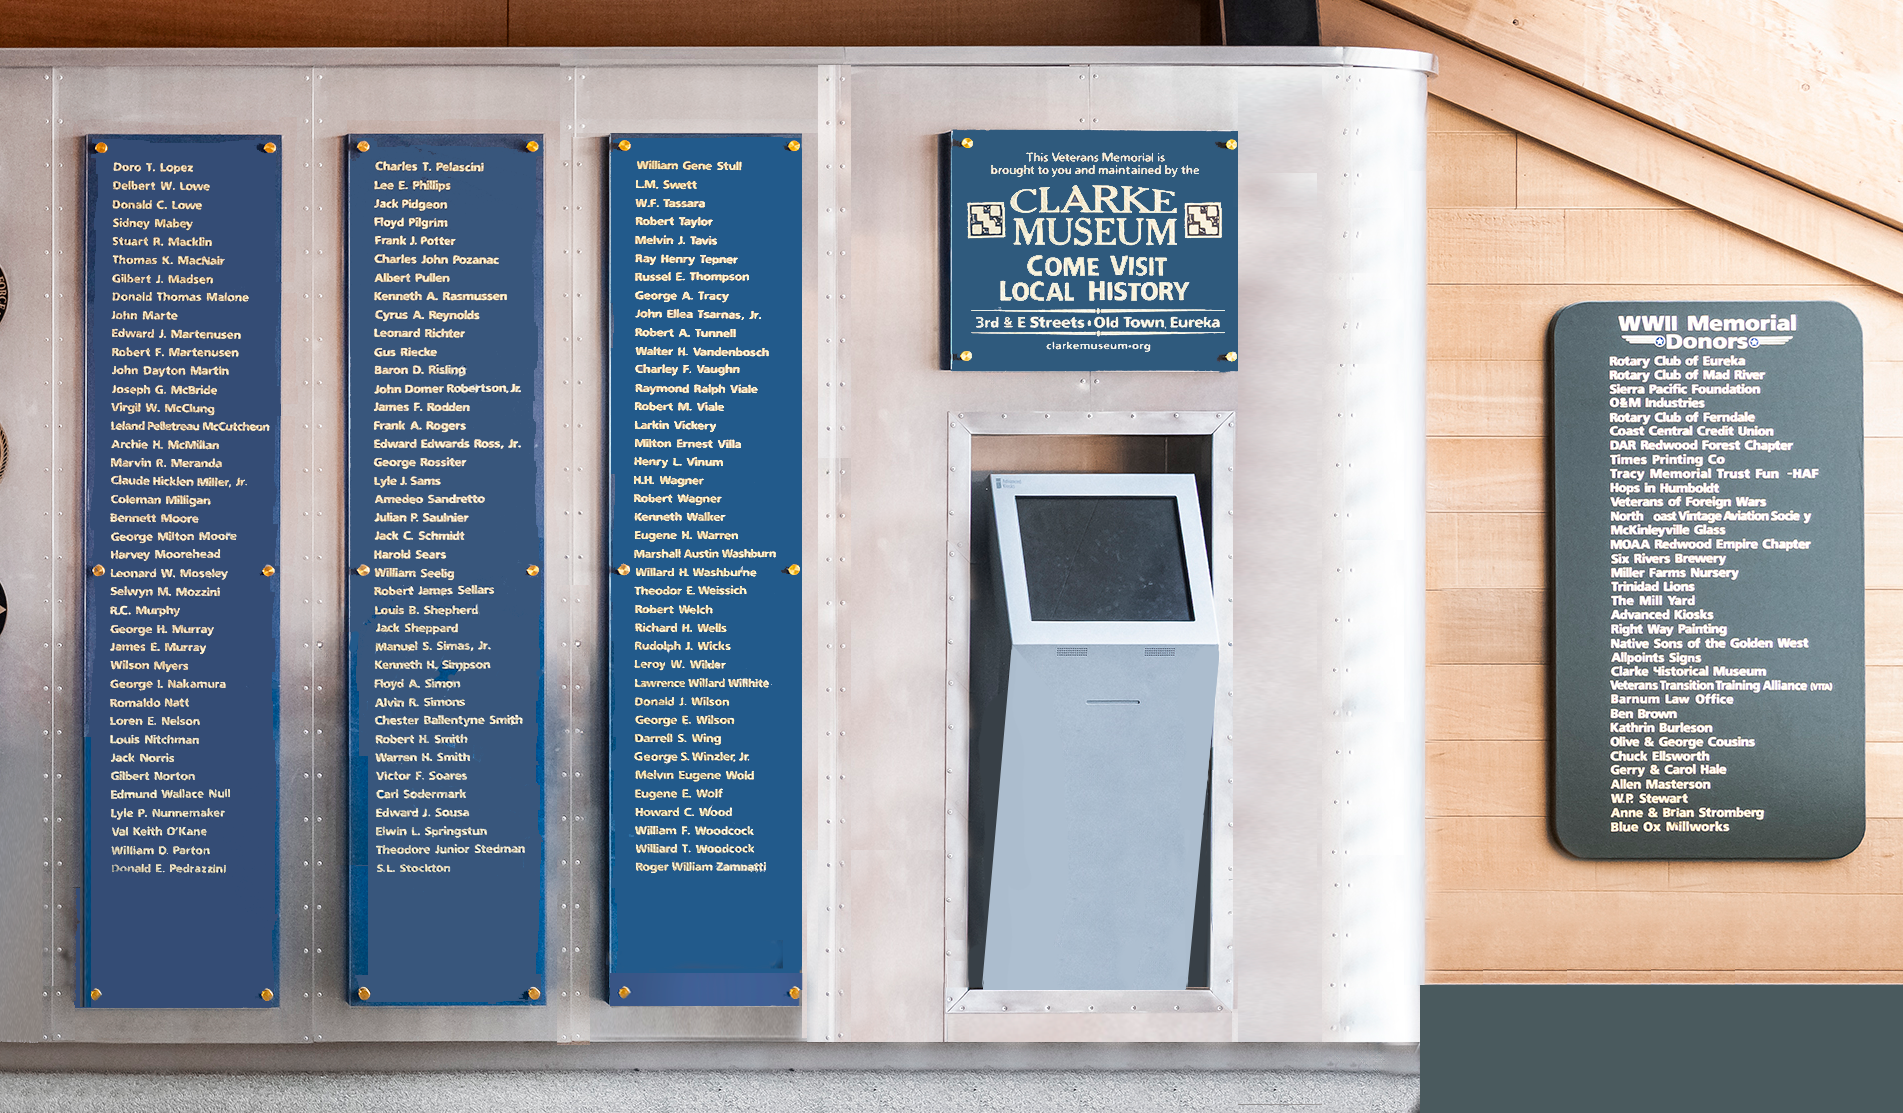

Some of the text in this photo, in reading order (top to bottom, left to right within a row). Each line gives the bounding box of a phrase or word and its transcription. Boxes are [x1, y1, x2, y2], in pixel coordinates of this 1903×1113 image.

[1025, 151, 1166, 163] This Veterans Memorial is
[990, 164, 1200, 178] brought to you and maintained by the
[1009, 184, 1178, 214] CLARKE
[112, 217, 194, 231] Sidney Mabey
[635, 215, 714, 229] Robert Taylor
[1012, 217, 1178, 247] MUSEUM
[374, 235, 457, 246] Frank J. Potter
[1026, 254, 1168, 277] COME VISIT
[634, 290, 730, 304] George A. Tracy
[999, 280, 1190, 302] LOCAL HISTORY
[110, 310, 179, 321] John Marte
[975, 316, 1000, 329] 3rd
[1003, 316, 1014, 329] &
[1017, 316, 1027, 329] E
[1169, 316, 1221, 329] Eureka
[1617, 313, 1797, 332] WWII Memorial
[373, 327, 466, 339] Leonard Richter
[1665, 333, 1749, 350] Donors
[1609, 354, 1746, 369] Rotary Club of Eureka
[1609, 383, 1761, 395] Sierra Pacific Foundation
[1609, 453, 1726, 468] Times Printing Co
[1610, 552, 1727, 566] Six Rivers Brewery
[1610, 594, 1696, 606] The Mill Yard
[1610, 708, 1678, 719] Ben Brown
[110, 752, 175, 763] Jack Norris
[1610, 750, 1710, 762] Chuck Ellsworth
[375, 770, 468, 781] Victor F. Soares
[634, 787, 724, 801] Eugene E. Wolf
[1610, 820, 1730, 833] Blue Ox Millworks
